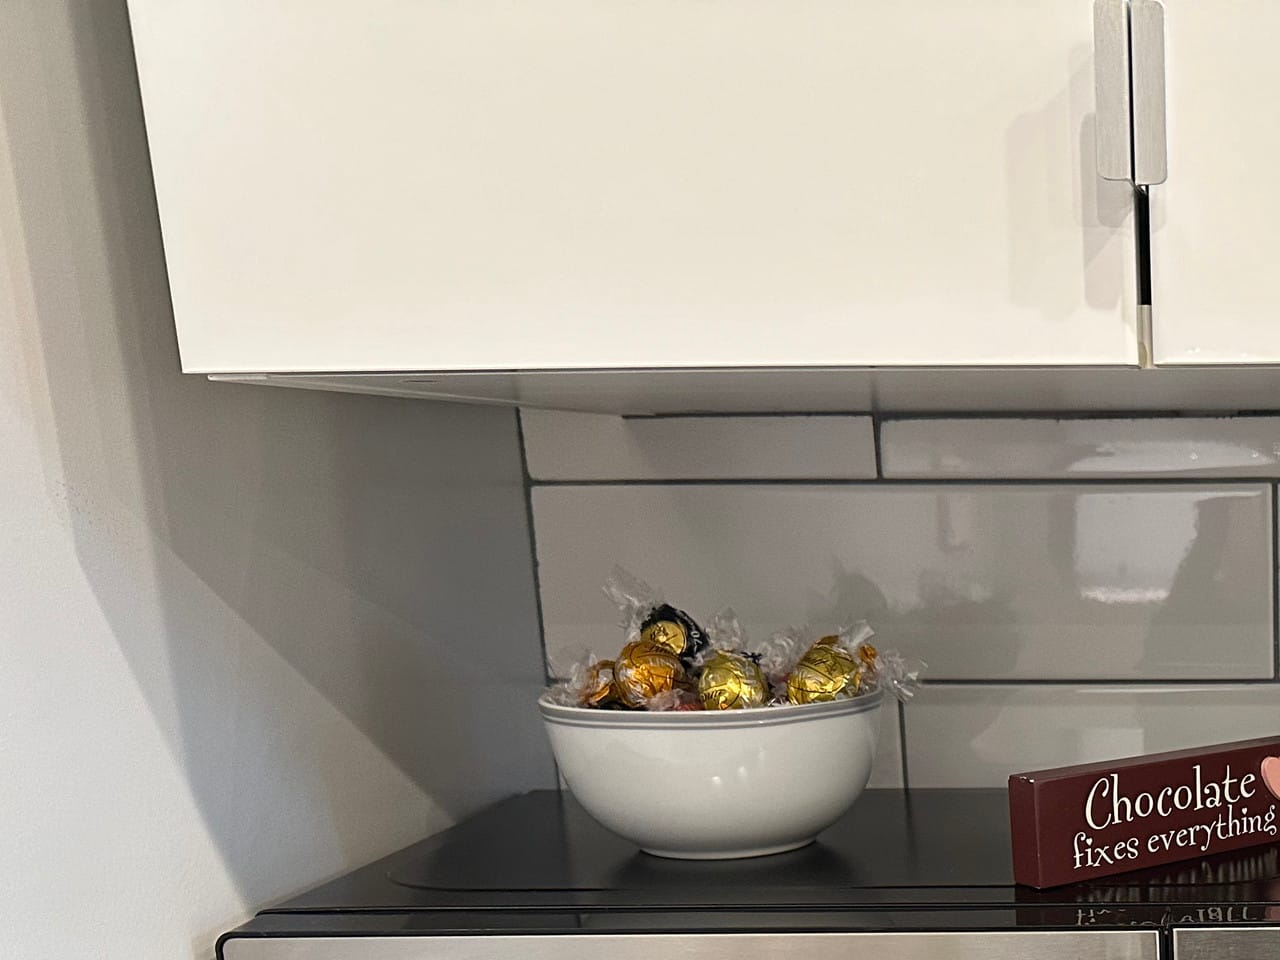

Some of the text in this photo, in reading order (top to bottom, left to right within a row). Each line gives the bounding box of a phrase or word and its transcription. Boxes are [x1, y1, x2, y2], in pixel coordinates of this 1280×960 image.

[1085, 765, 1256, 831] Chocolate
[1072, 804, 1278, 870] fixes everything
